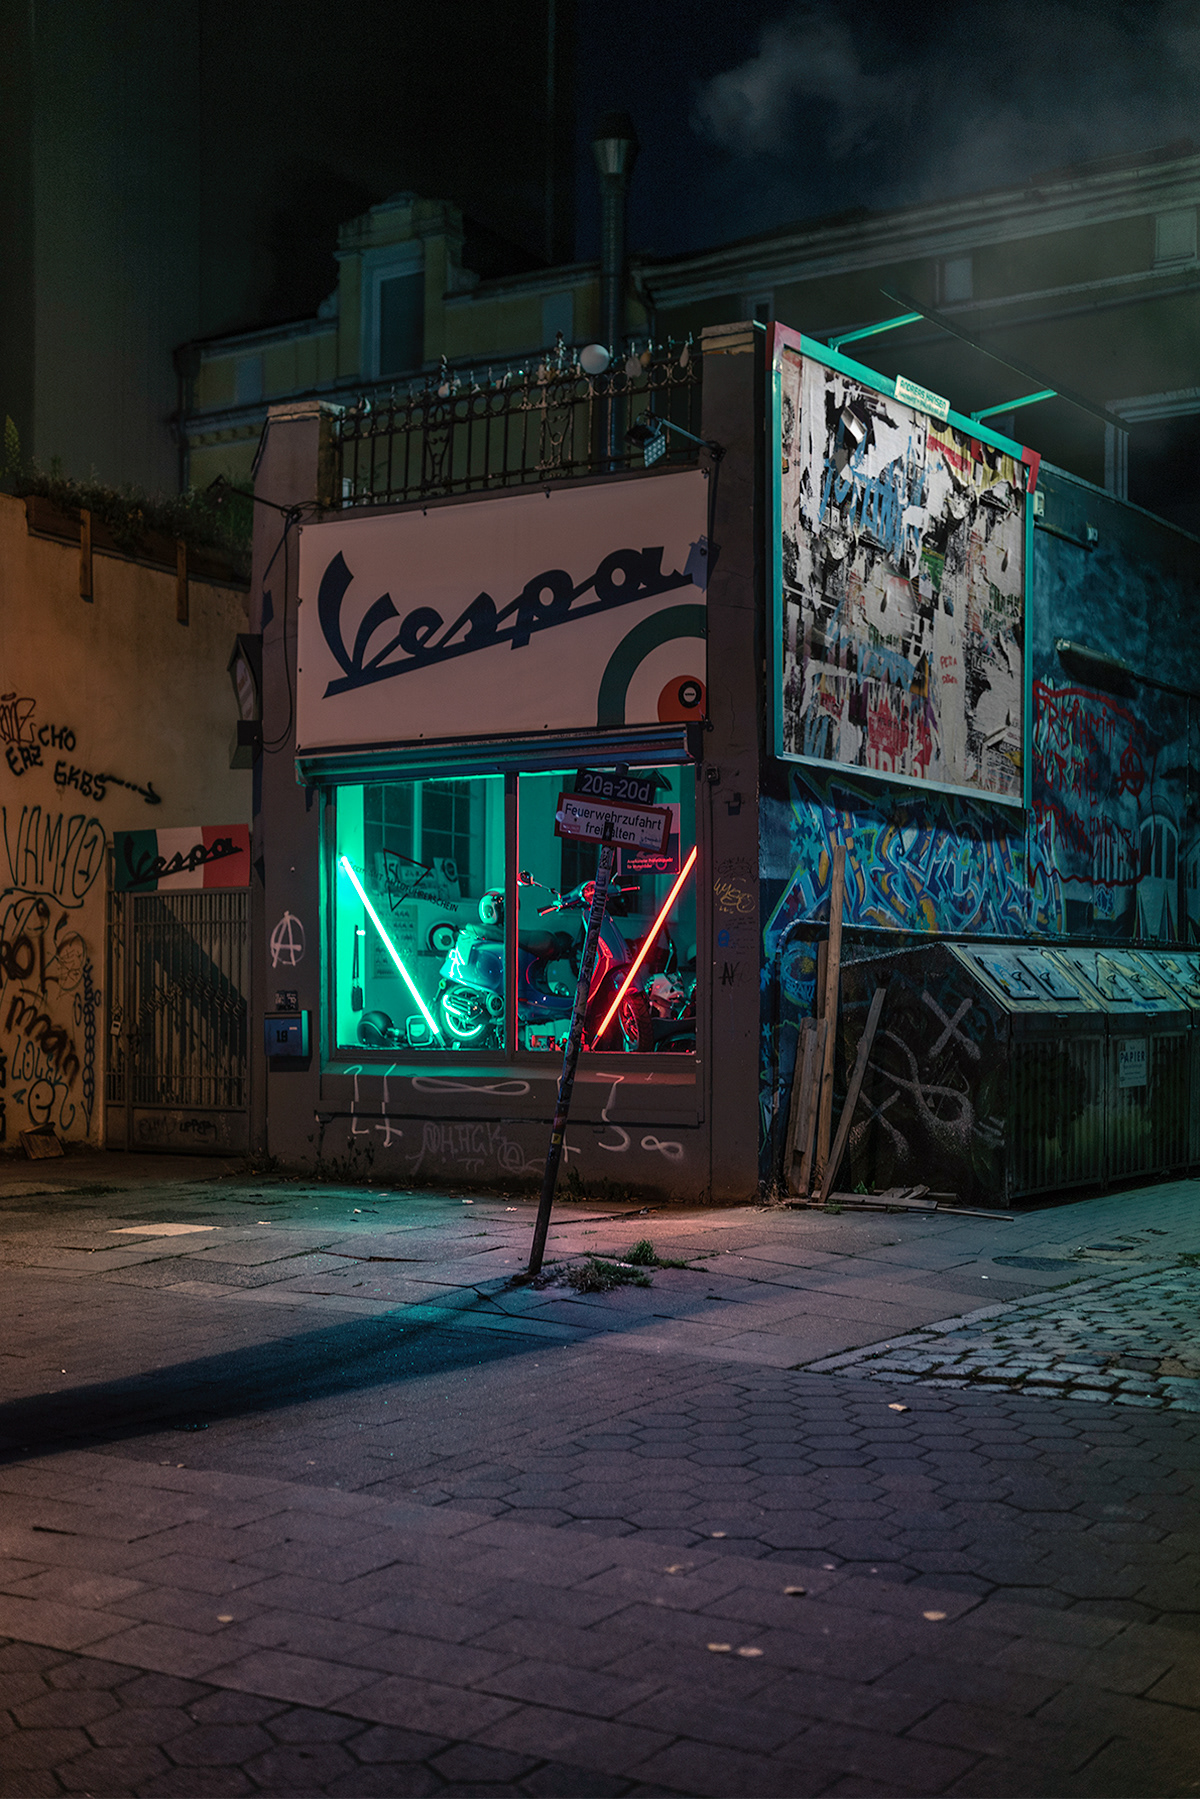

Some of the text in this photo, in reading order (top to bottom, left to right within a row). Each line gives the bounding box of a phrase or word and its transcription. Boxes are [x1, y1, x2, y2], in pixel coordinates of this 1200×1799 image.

[322, 550, 693, 700] Vespa
[581, 774, 650, 802] 20a-20d
[565, 803, 662, 831] Feuerwehrzufahrt
[585, 822, 636, 841] freialten
[124, 834, 244, 888] Vespa
[1120, 1051, 1145, 1063] PAPIER
